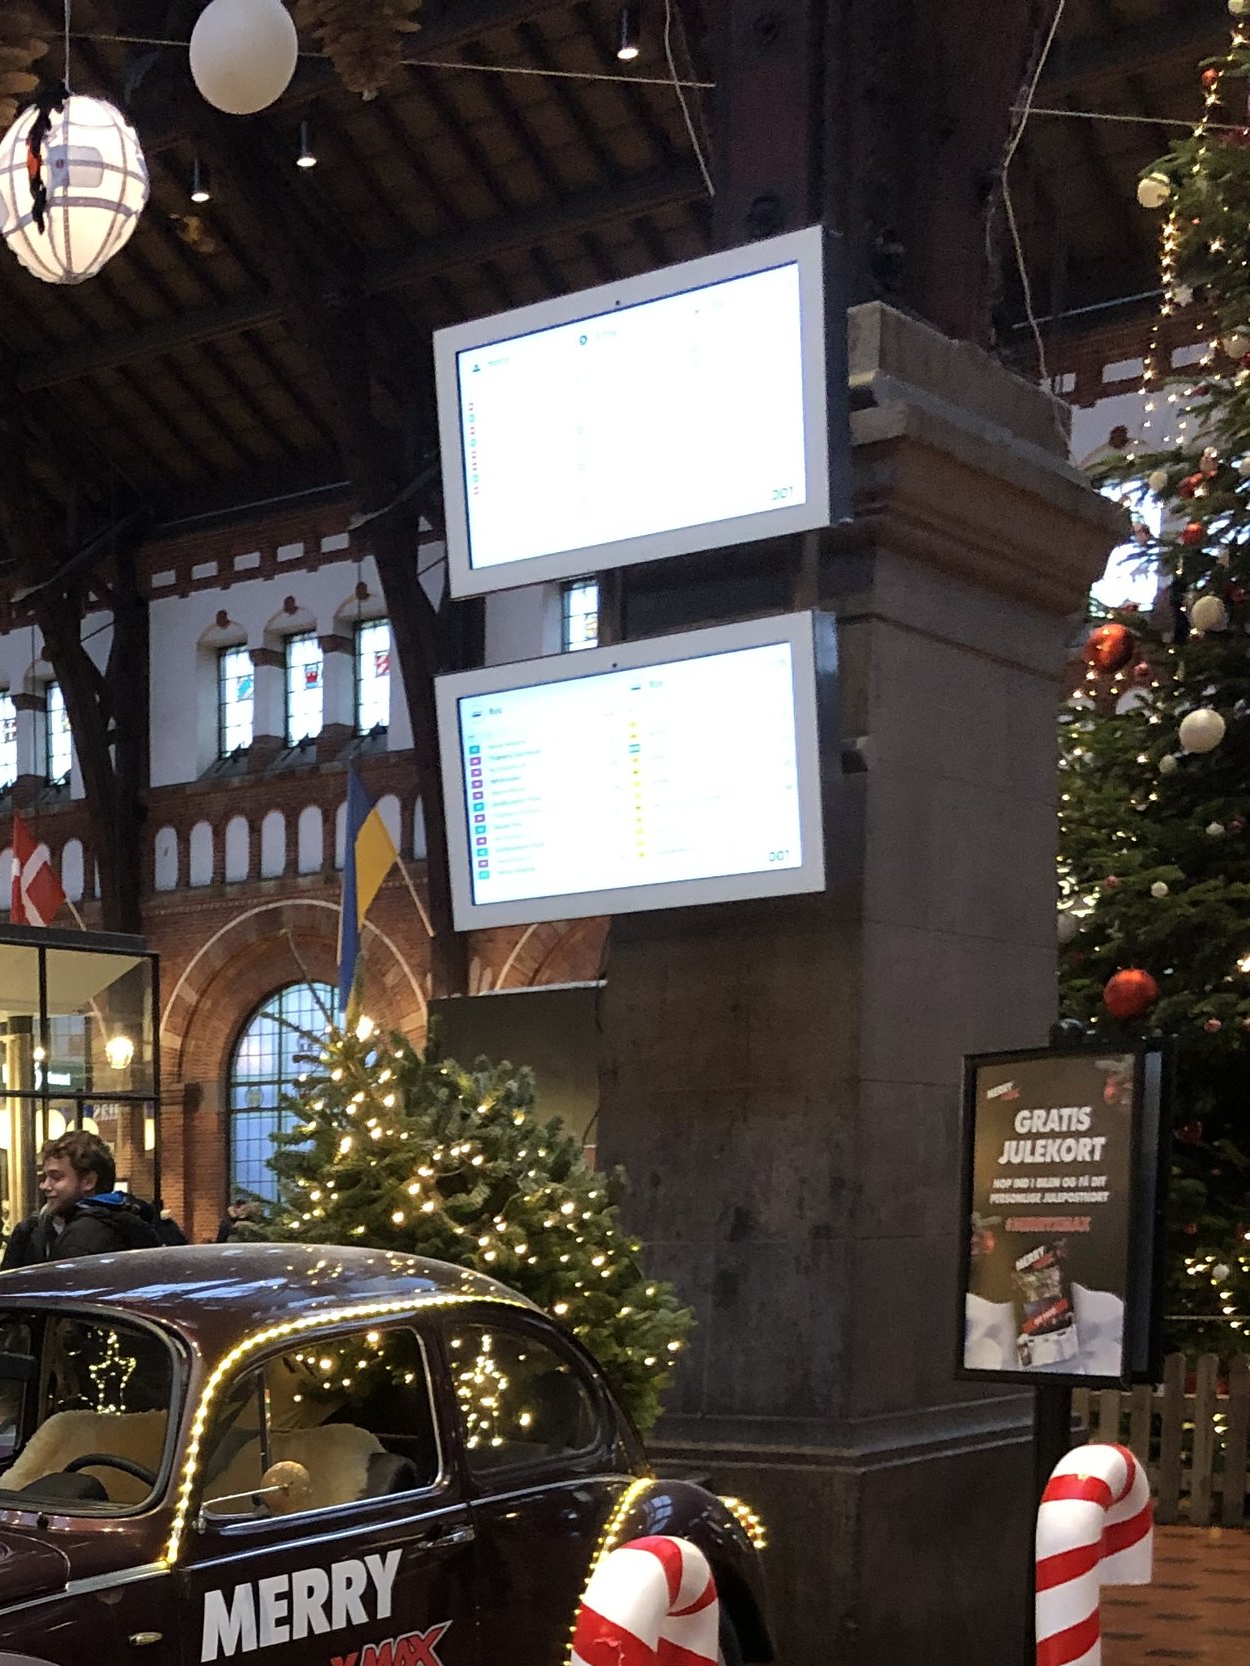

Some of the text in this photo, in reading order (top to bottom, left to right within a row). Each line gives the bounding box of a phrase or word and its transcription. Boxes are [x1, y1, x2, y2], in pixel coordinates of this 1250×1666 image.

[1014, 1106, 1092, 1135] GRATIS
[997, 1136, 1107, 1165] JULEKORT
[200, 1548, 404, 1663] MERRY
